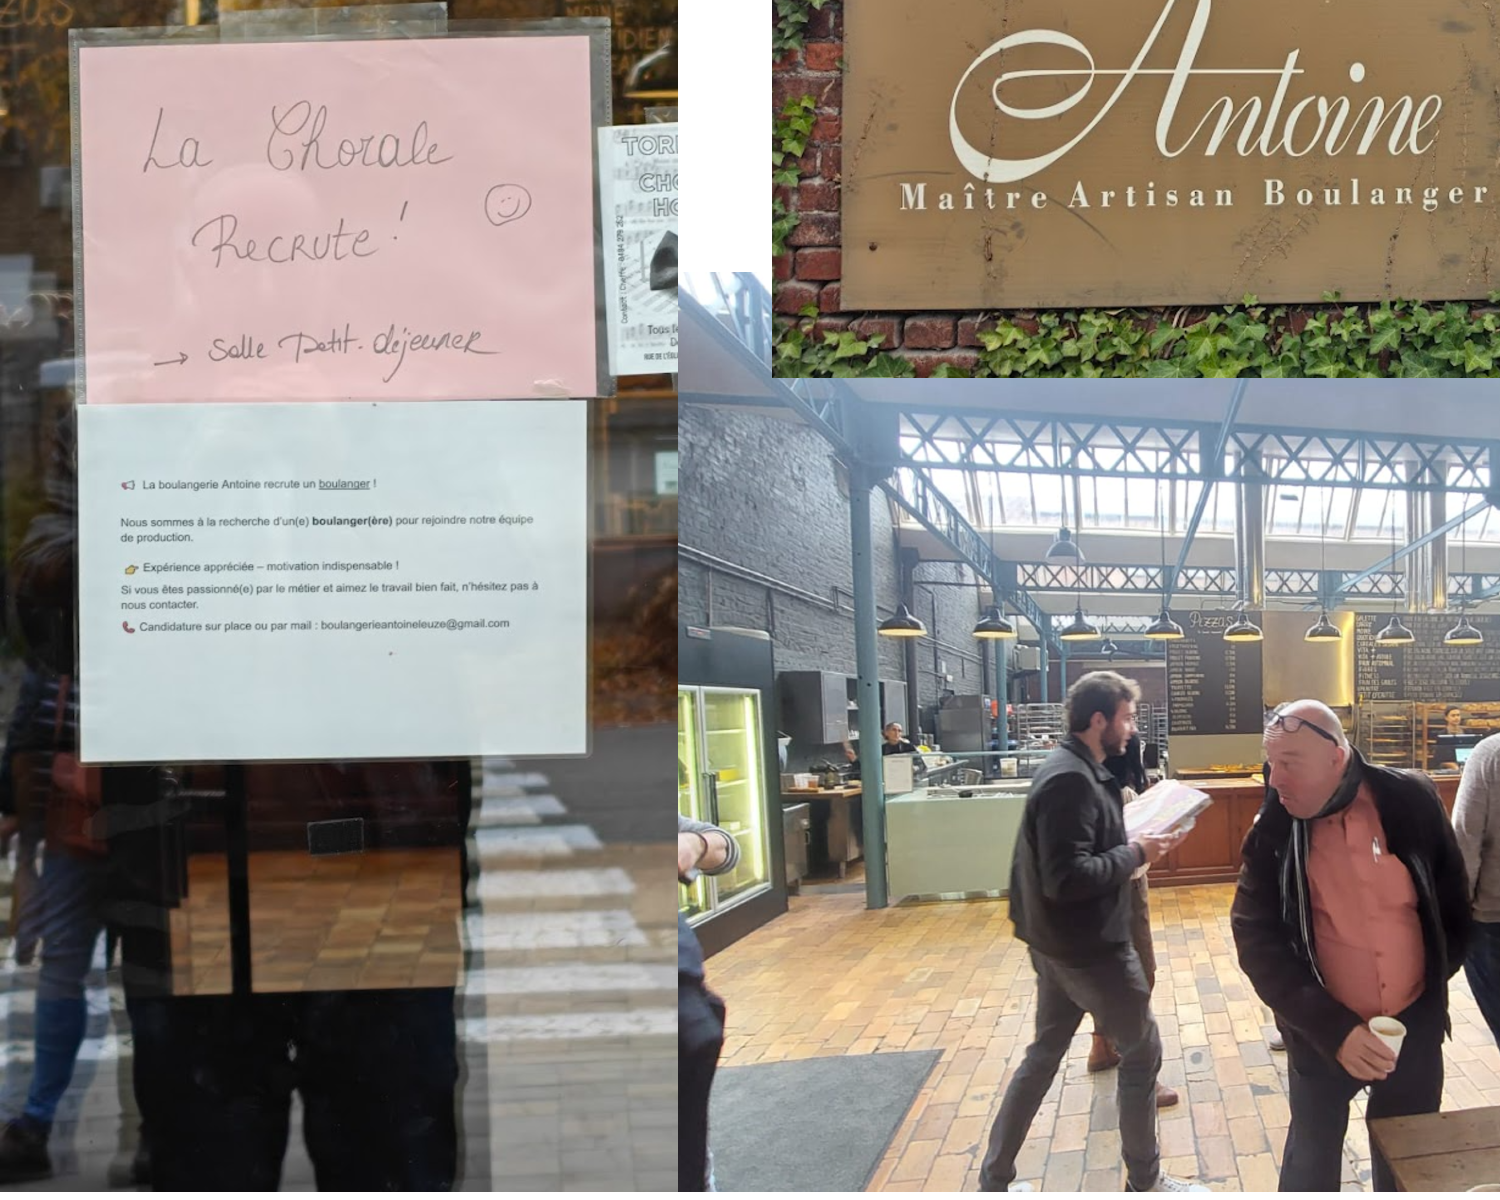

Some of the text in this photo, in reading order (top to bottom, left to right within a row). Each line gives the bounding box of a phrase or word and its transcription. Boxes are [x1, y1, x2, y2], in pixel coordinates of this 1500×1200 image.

[143, 100, 454, 173] La Chorale
[621, 134, 678, 156] TOR
[900, 178, 1489, 213] Maître Artisan Boulanger
[647, 324, 670, 335] Tous
[142, 479, 156, 491] La
[157, 479, 220, 492] boulangerie
[220, 478, 262, 490] Antoine
[263, 479, 301, 490] recrute
[302, 480, 317, 490] un
[317, 478, 371, 491] boulanger
[119, 513, 534, 529] Nous sommes à la recherche d'un(e) boulanger(ère) pour rejoindre notre équipe
[119, 531, 194, 545] de production.
[142, 561, 202, 575] Expérience
[202, 560, 255, 575] appréciée
[265, 560, 320, 572] motivation
[321, 560, 394, 573] indispensable
[120, 580, 540, 597] Si vous êtes passionné(e) par le métier et aimez le travail bien fait, n'hésitez pas à
[120, 599, 200, 610] nous contacter.
[138, 621, 203, 632] Candidature
[204, 622, 223, 632] sur
[223, 620, 253, 634] place
[253, 622, 269, 631] ou
[270, 622, 289, 633] par
[289, 620, 313, 631] mail
